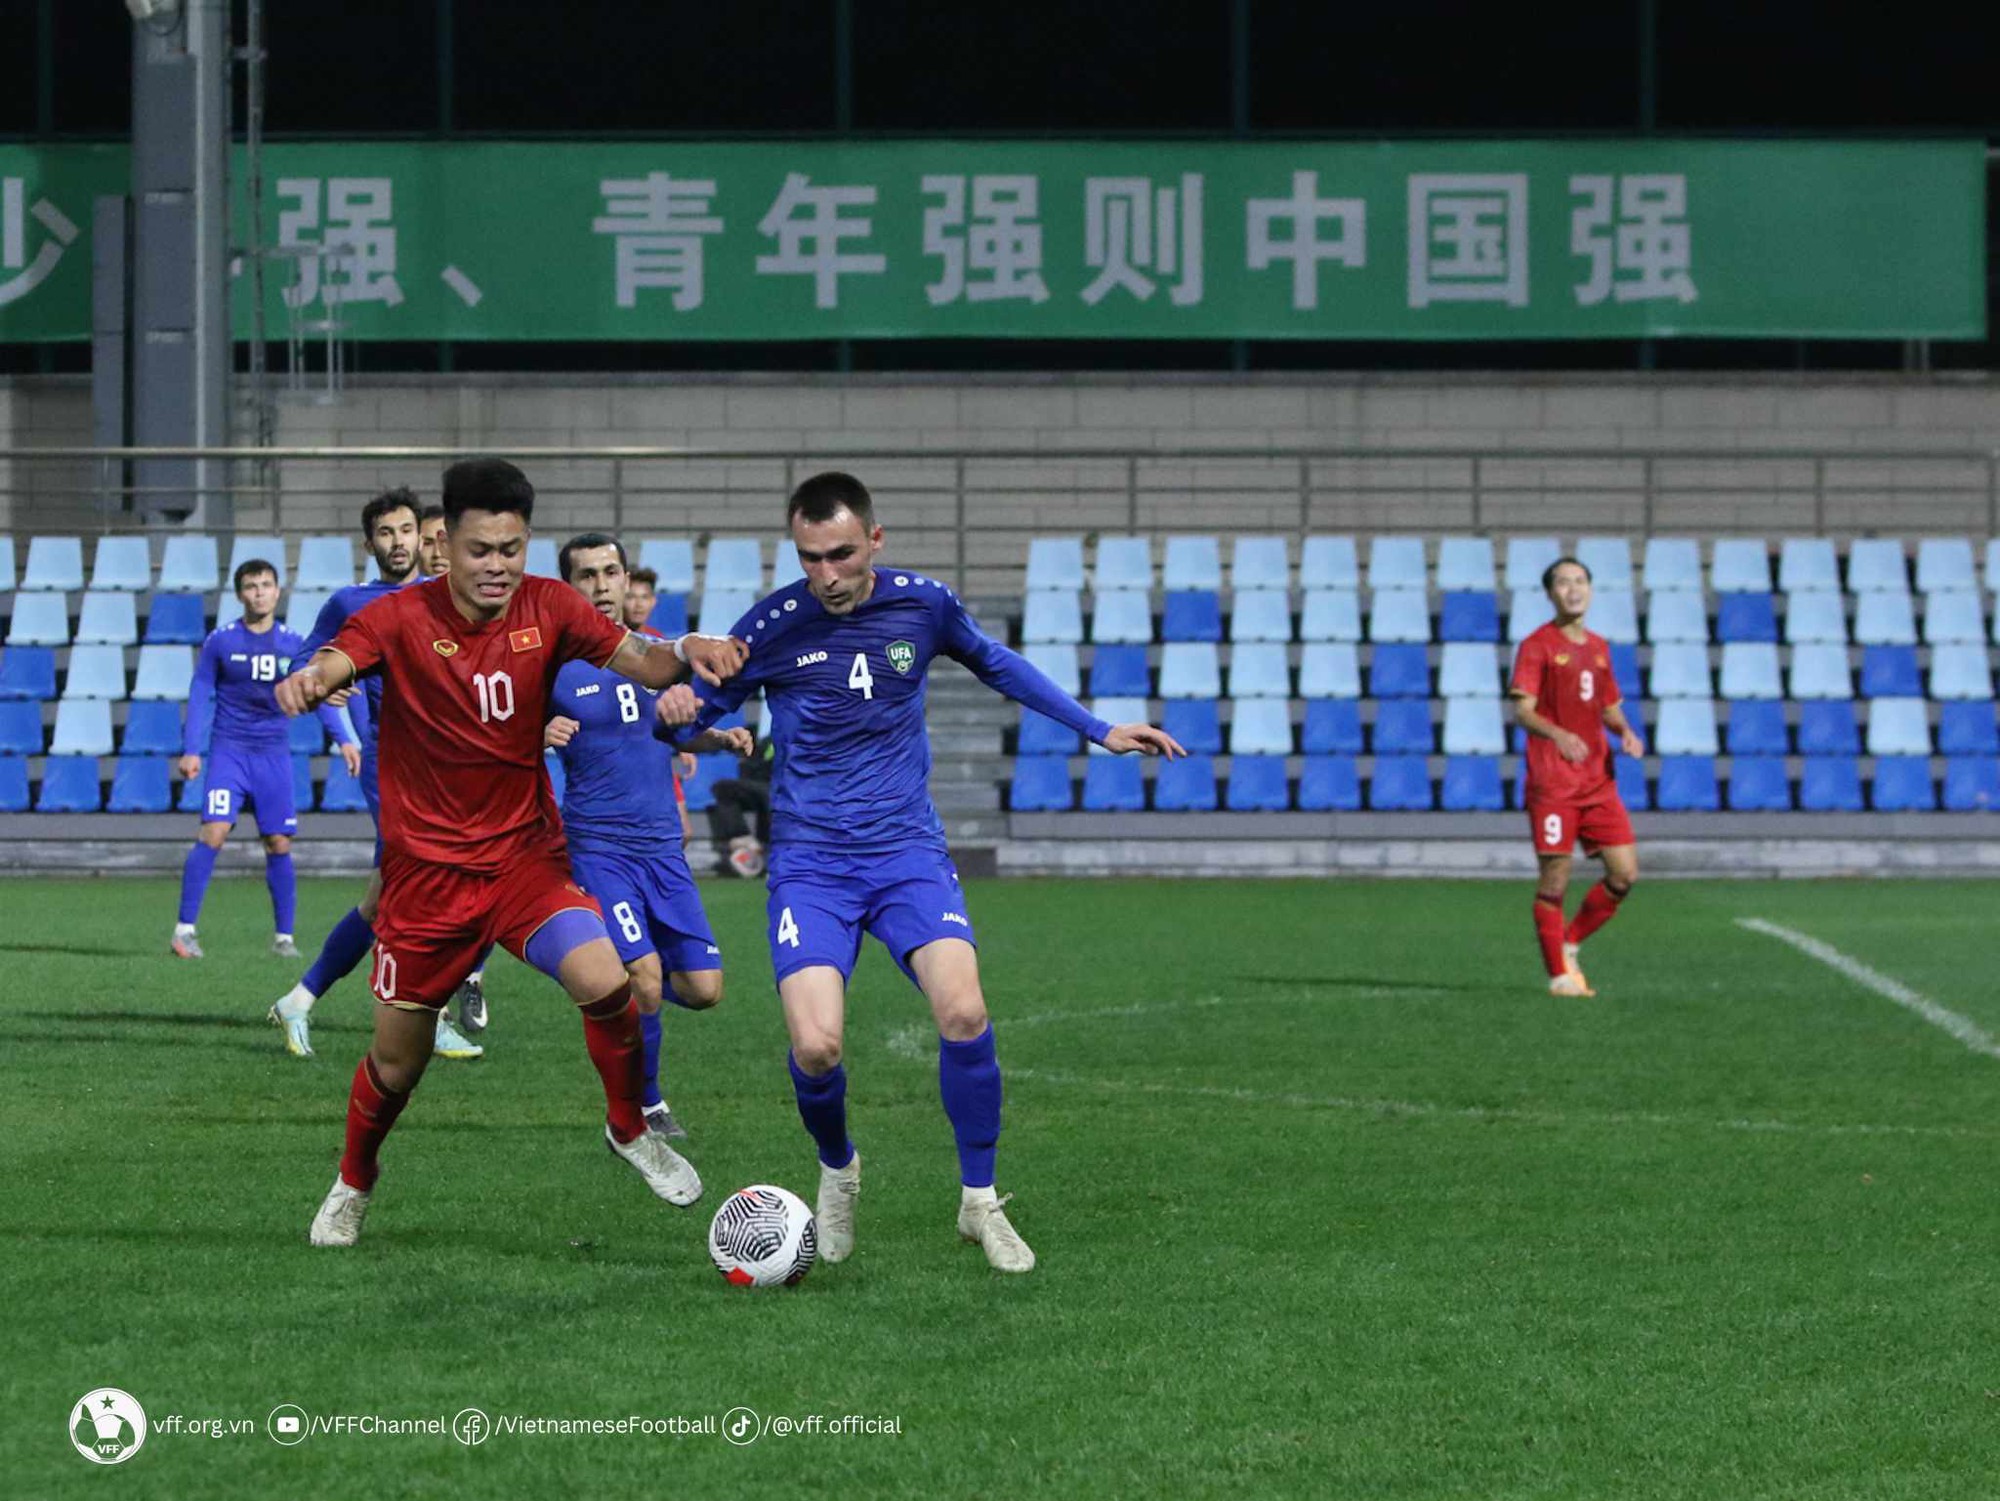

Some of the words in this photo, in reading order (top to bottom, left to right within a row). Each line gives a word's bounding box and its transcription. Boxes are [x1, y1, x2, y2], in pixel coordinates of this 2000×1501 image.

[251, 654, 276, 681] 19
[796, 651, 828, 667] JAKO
[890, 647, 912, 661] UFA
[575, 684, 600, 697] JAKO
[848, 653, 874, 700] 4
[1579, 670, 1594, 701] 9
[473, 670, 515, 723] 10
[616, 683, 640, 723] 8
[208, 788, 231, 815] 19
[1544, 813, 1562, 846] 9
[612, 901, 642, 944] 8
[777, 906, 800, 949] 4
[373, 943, 397, 1000] 10
